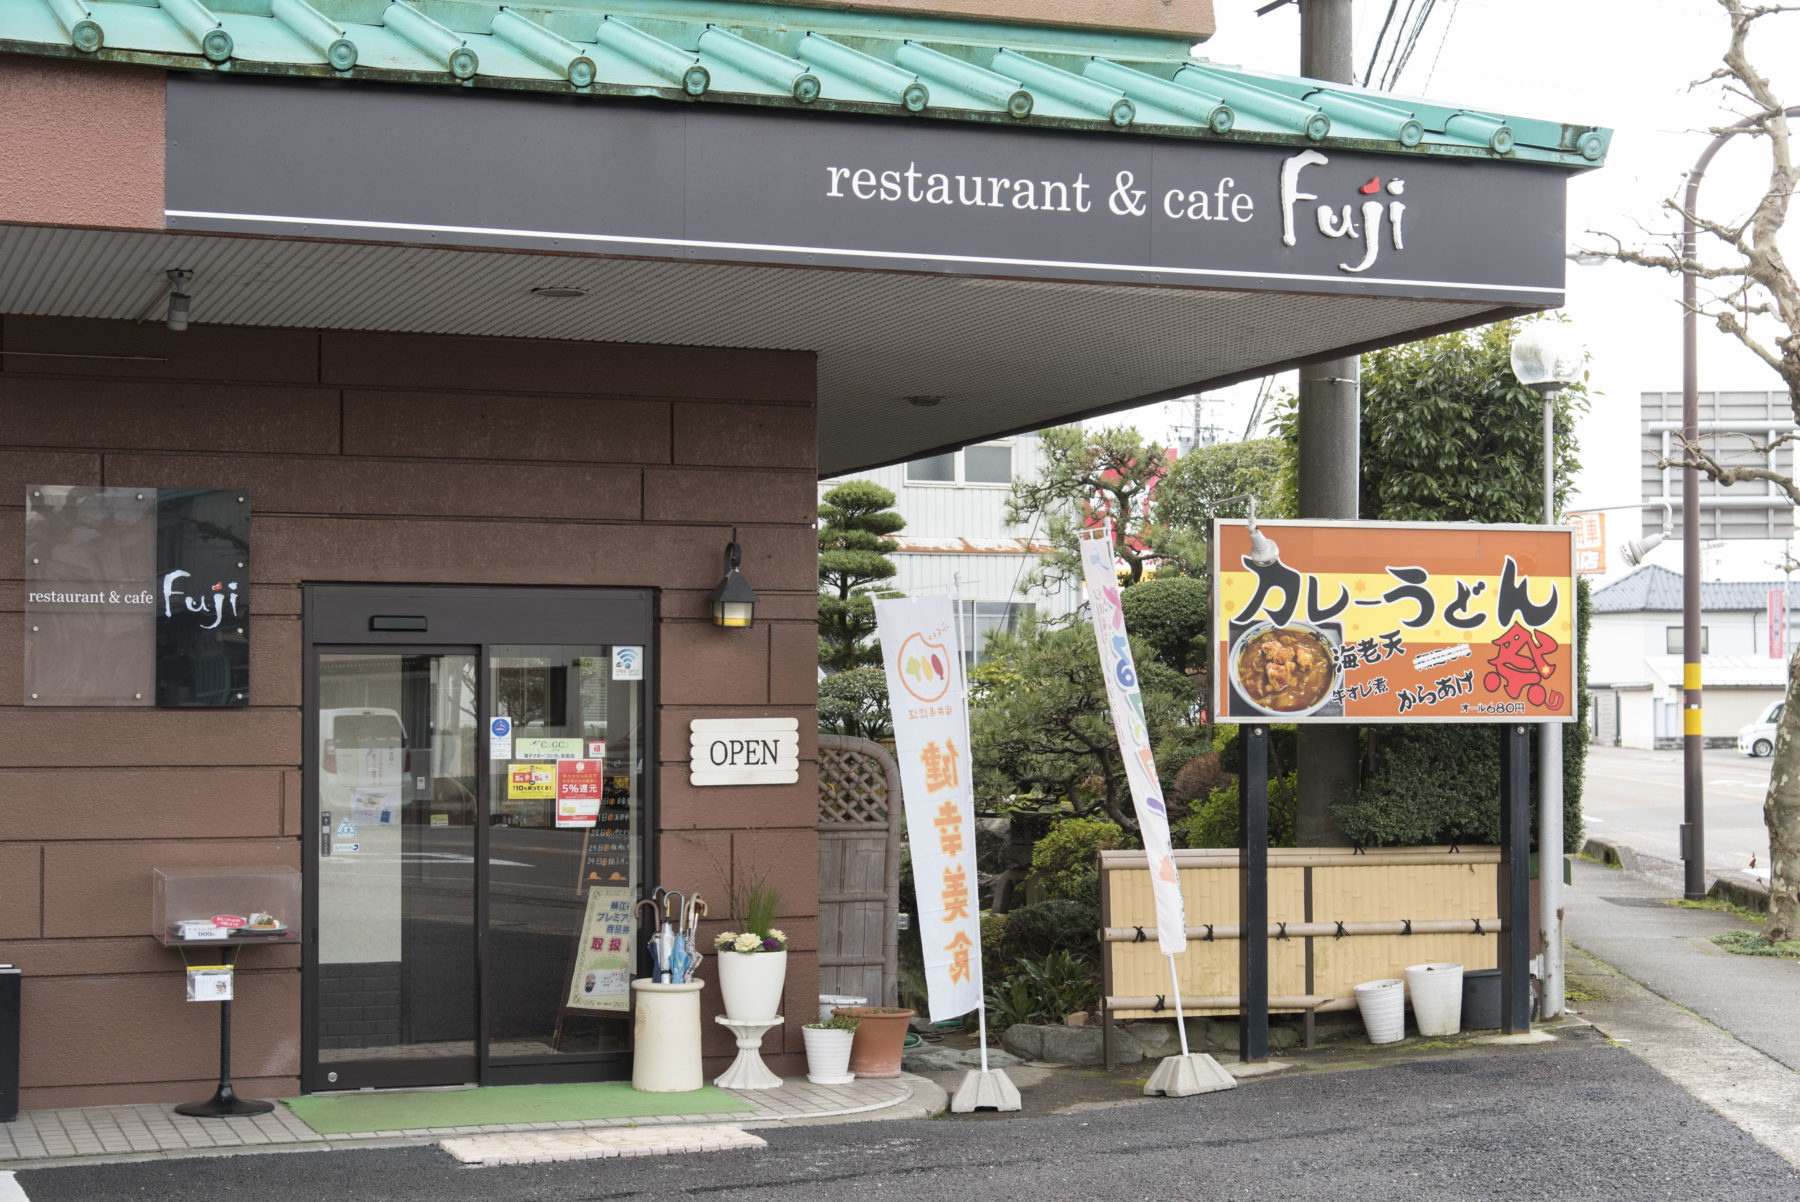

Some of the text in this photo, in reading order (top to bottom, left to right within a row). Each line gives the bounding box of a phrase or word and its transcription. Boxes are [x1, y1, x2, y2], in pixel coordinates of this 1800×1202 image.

[827, 148, 1406, 272] restaurant & cafe Fuji
[28, 569, 239, 629] restaurant & cafe Fuji
[1231, 555, 1558, 629] カレーうどん
[1332, 629, 1406, 674] 海老天
[1331, 676, 1390, 704] 牛すじ煮
[1397, 670, 1475, 713] からあげ
[1461, 702, 1526, 715] オール680円
[710, 739, 780, 766] OPEN
[562, 784, 598, 793] 5%還元
[596, 912, 629, 922] プレミア
[591, 937, 630, 953] 取扱
